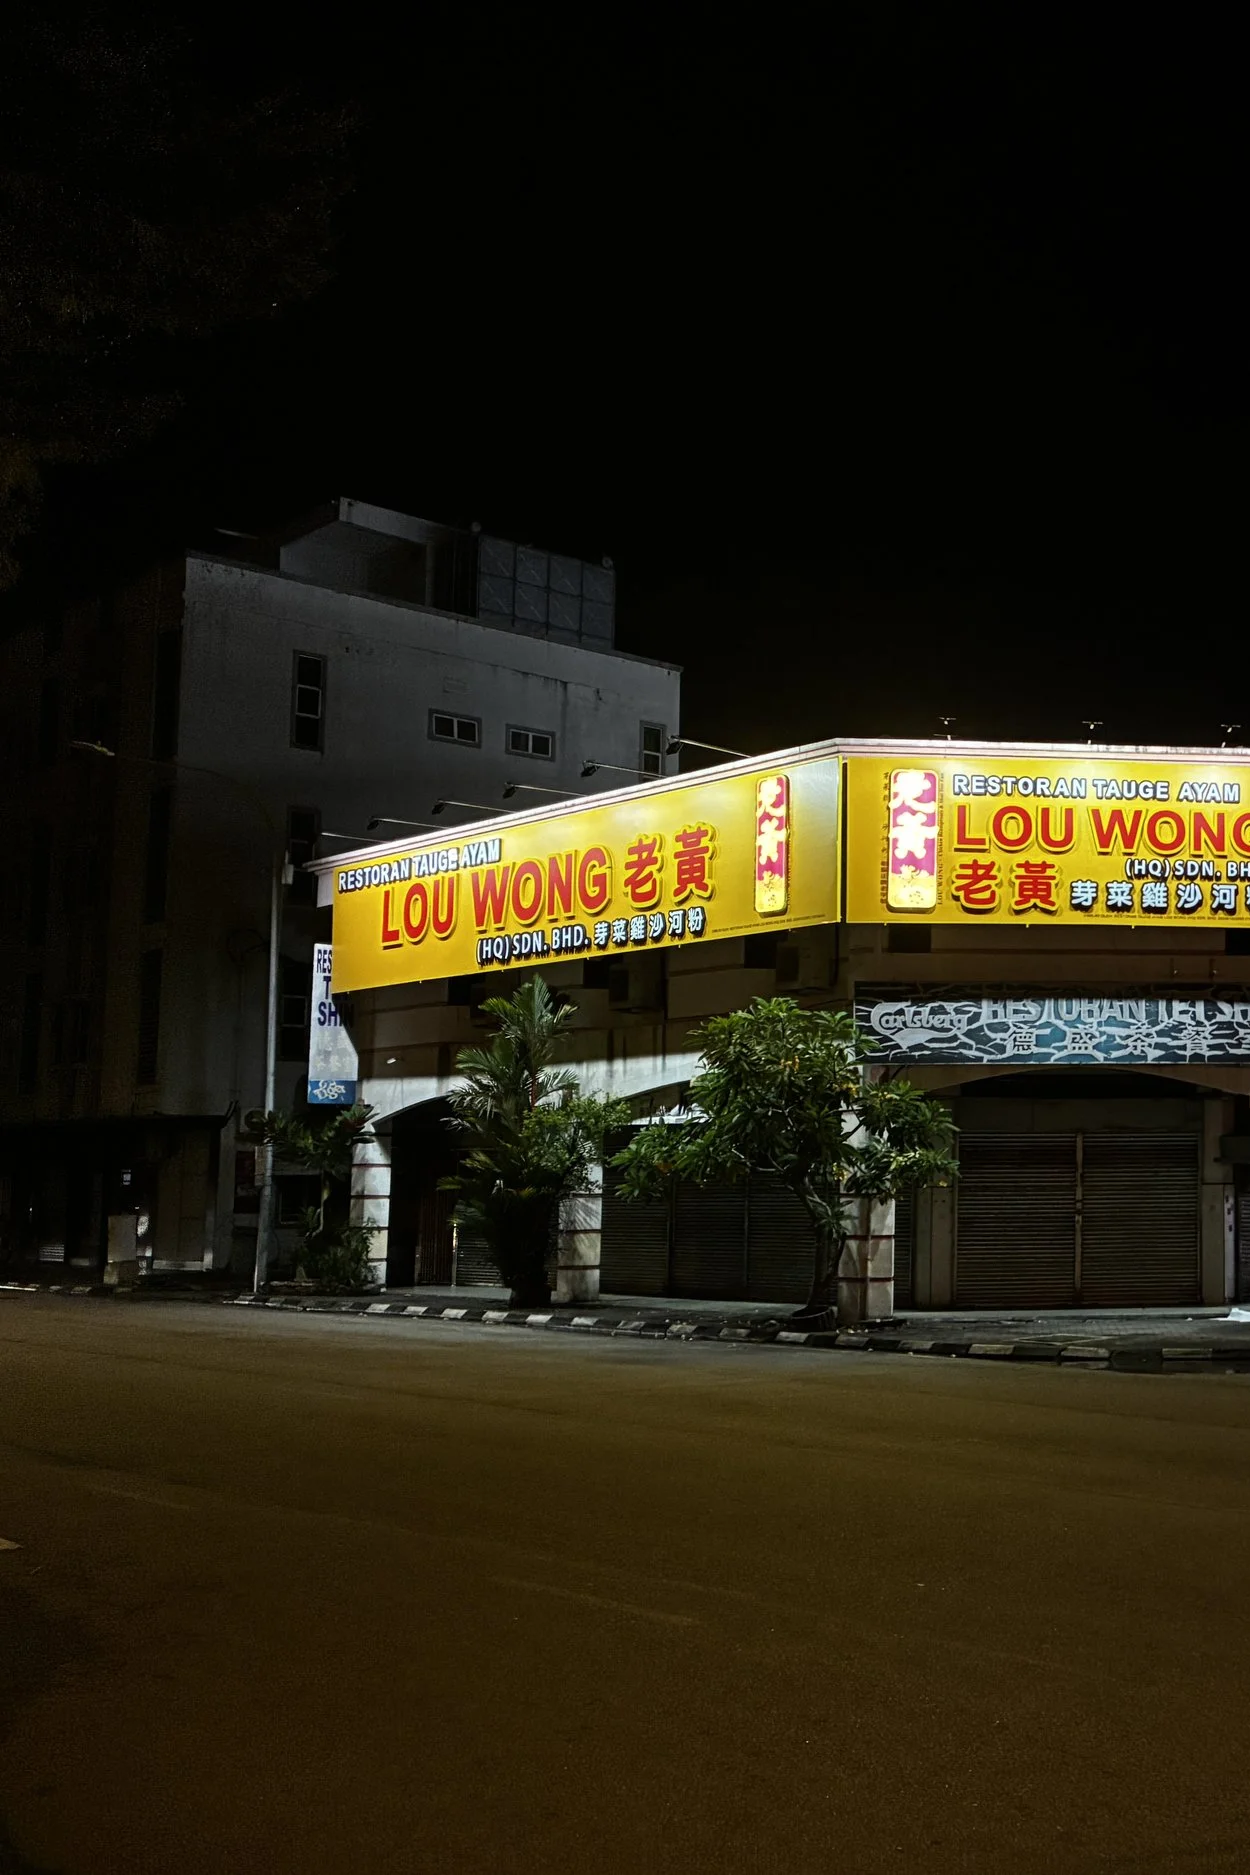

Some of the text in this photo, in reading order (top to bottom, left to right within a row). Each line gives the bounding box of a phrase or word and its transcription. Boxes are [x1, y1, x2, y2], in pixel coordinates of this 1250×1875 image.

[954, 775, 1087, 799] RESTORAN
[1092, 778, 1169, 801] TAUGE
[1178, 782, 1240, 803] AYAM
[956, 805, 1074, 850] LOU
[338, 838, 501, 892] RESTORAN TAUGE AYAM
[954, 860, 1057, 909] 老黃
[381, 826, 710, 944] LOU WONG 老黃
[551, 926, 589, 950] BHD.
[870, 1001, 968, 1035] Carlsberg
[982, 993, 1146, 1021] RESTORAN
